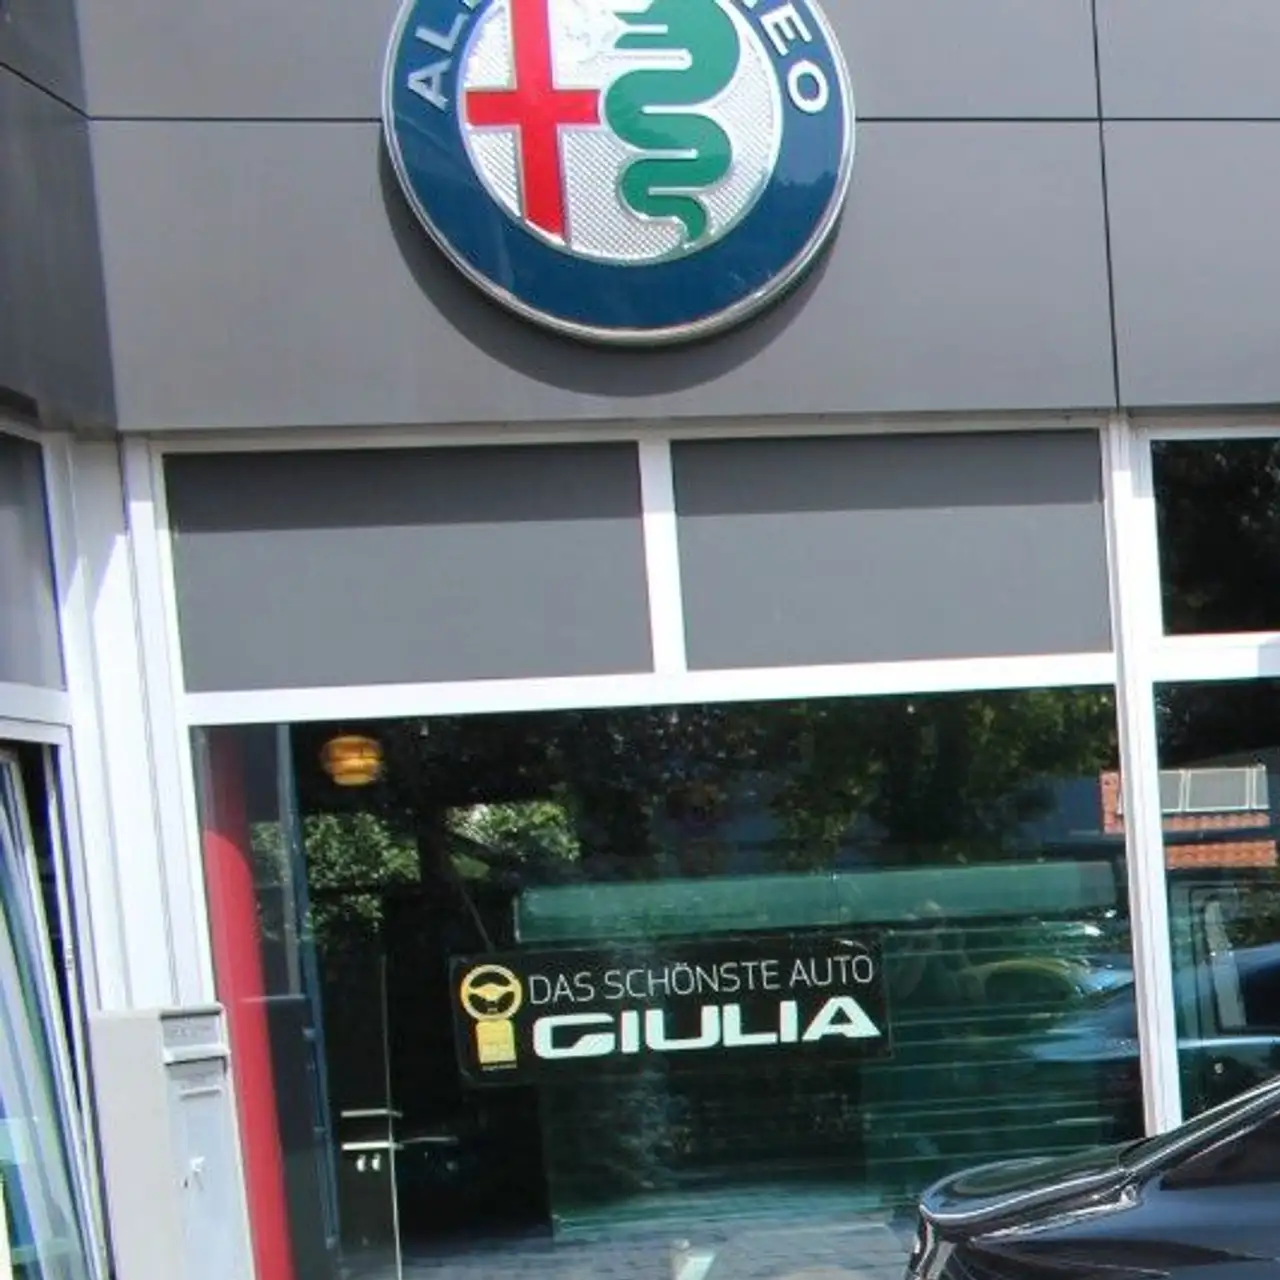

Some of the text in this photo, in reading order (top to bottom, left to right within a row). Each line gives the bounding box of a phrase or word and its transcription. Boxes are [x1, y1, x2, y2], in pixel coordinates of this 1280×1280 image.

[408, 0, 478, 110] AL
[527, 955, 874, 1005] DAS SCHÖNSTE AUTO
[532, 995, 881, 1060] GIULIA
